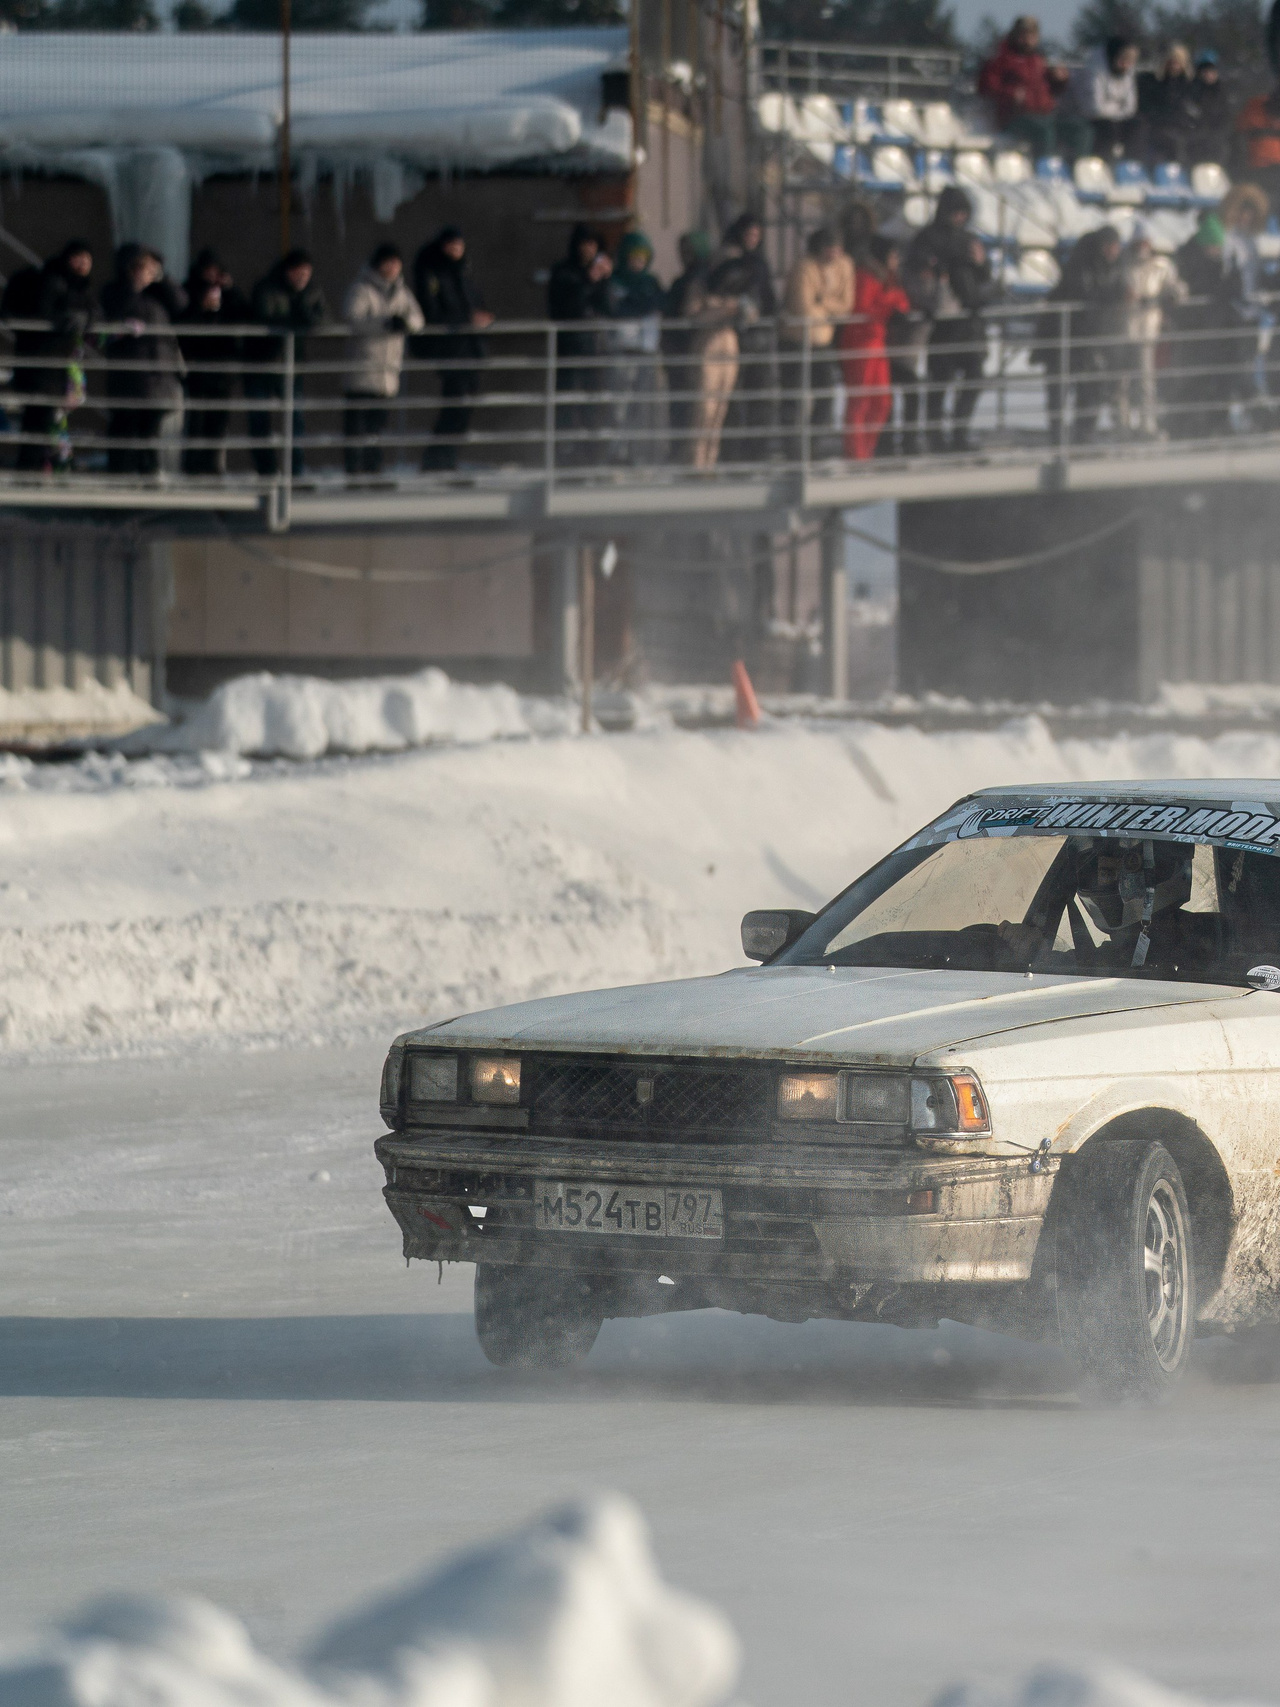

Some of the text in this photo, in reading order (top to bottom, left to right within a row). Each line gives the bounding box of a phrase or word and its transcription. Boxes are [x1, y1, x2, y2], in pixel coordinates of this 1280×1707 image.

[984, 806, 1051, 821] DRIFT
[1034, 803, 1189, 832] WINTER
[668, 1193, 712, 1222] 797
[680, 1222, 703, 1234] RUS
